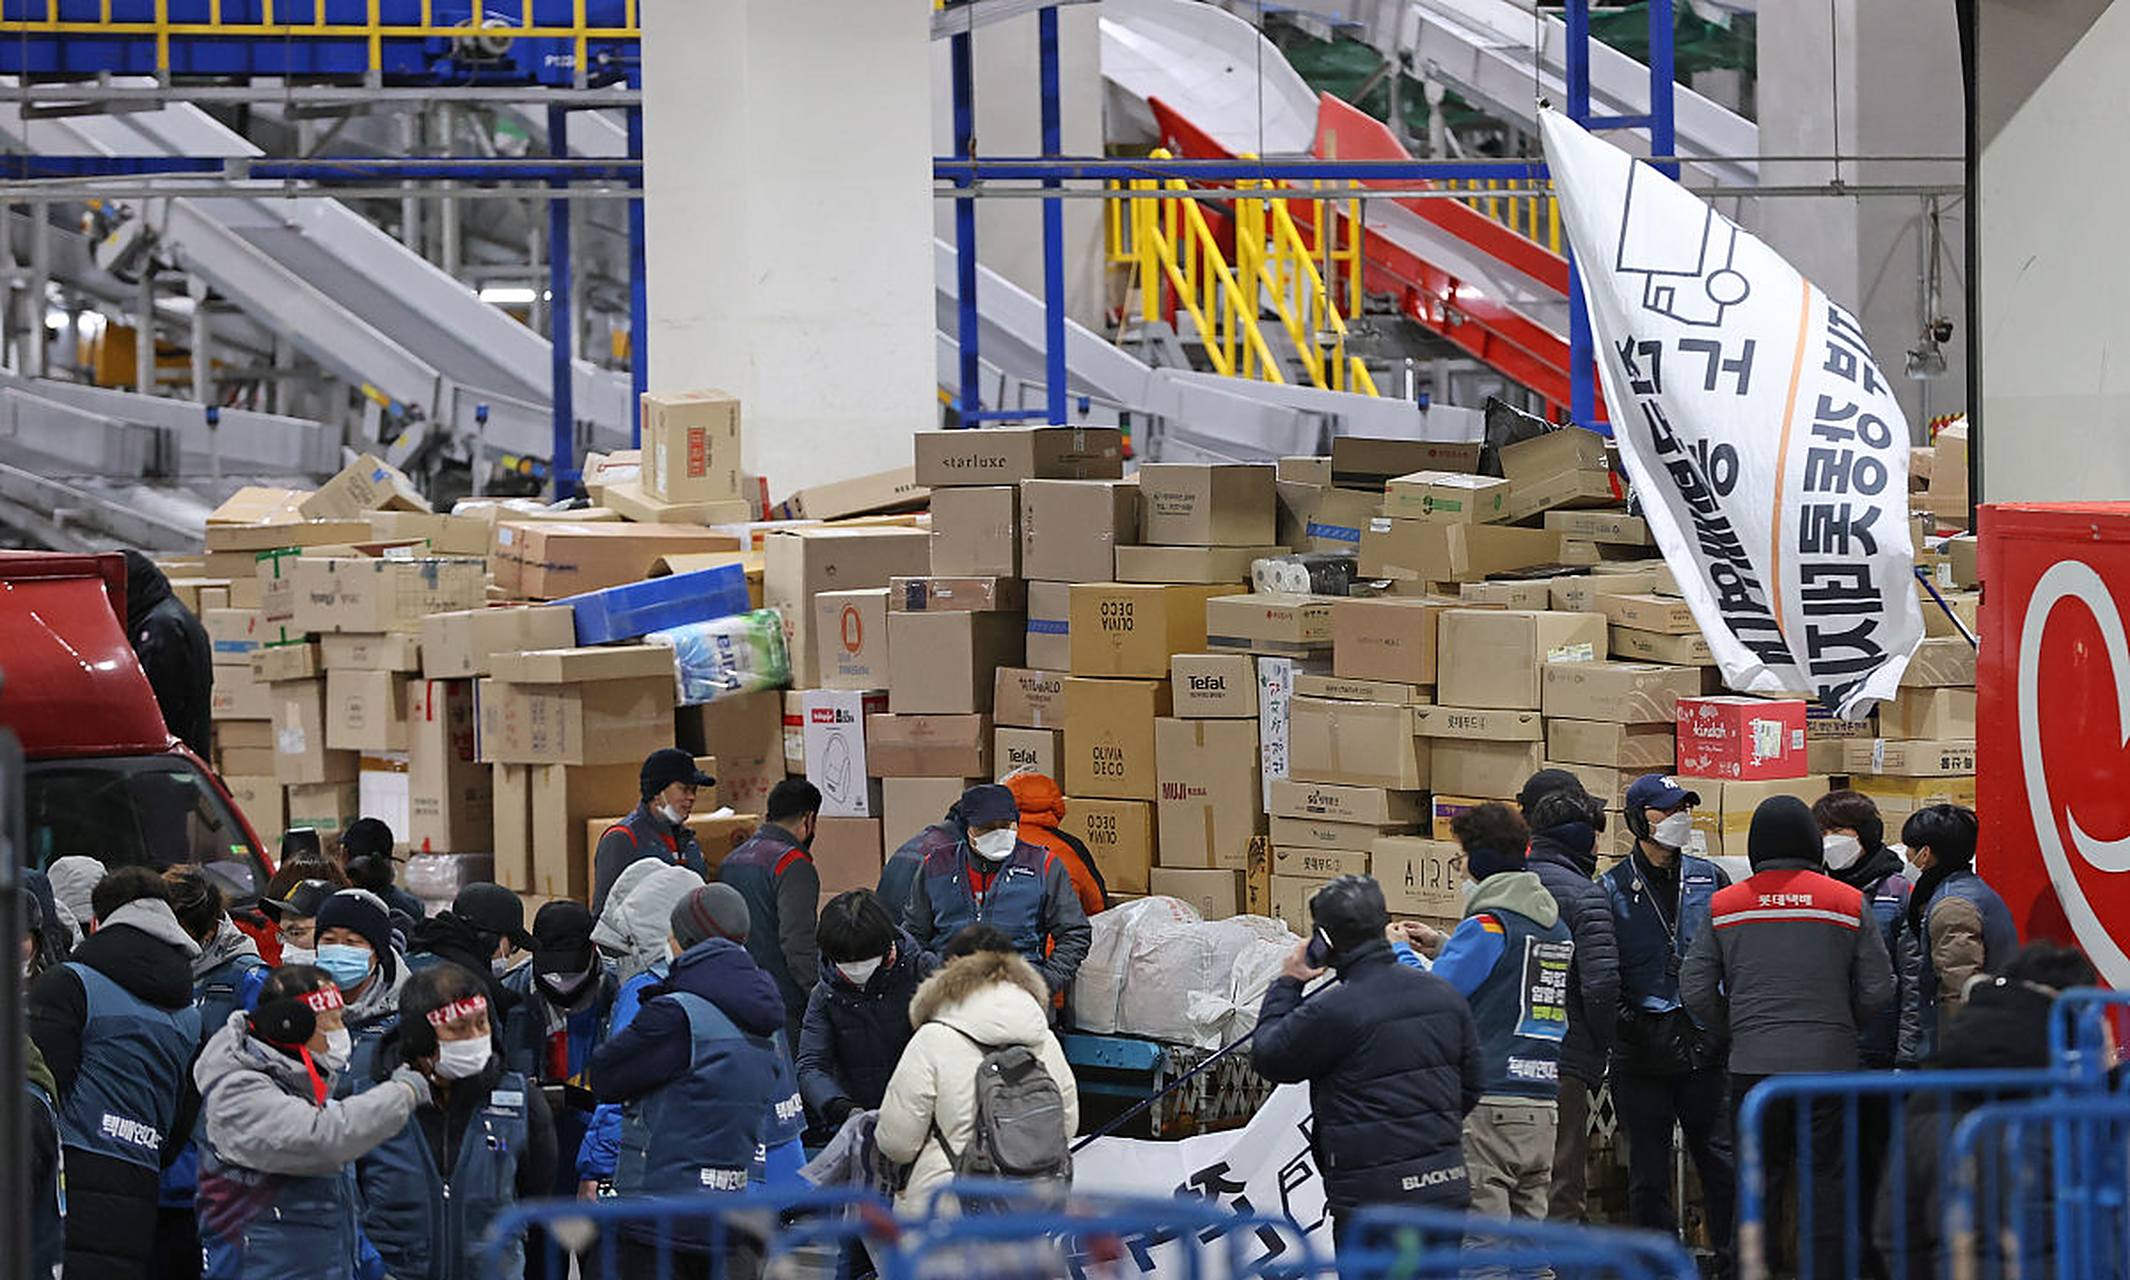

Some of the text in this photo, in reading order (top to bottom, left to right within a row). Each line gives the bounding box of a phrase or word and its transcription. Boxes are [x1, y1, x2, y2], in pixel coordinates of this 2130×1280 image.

[1100, 602, 1133, 616] DECO
[1187, 676, 1226, 690] Tefal
[1008, 748, 1038, 764] Tefal
[1092, 761, 1125, 776] DECO
[1087, 814, 1116, 830] DECO
[1758, 893, 1813, 907] 롯데택배
